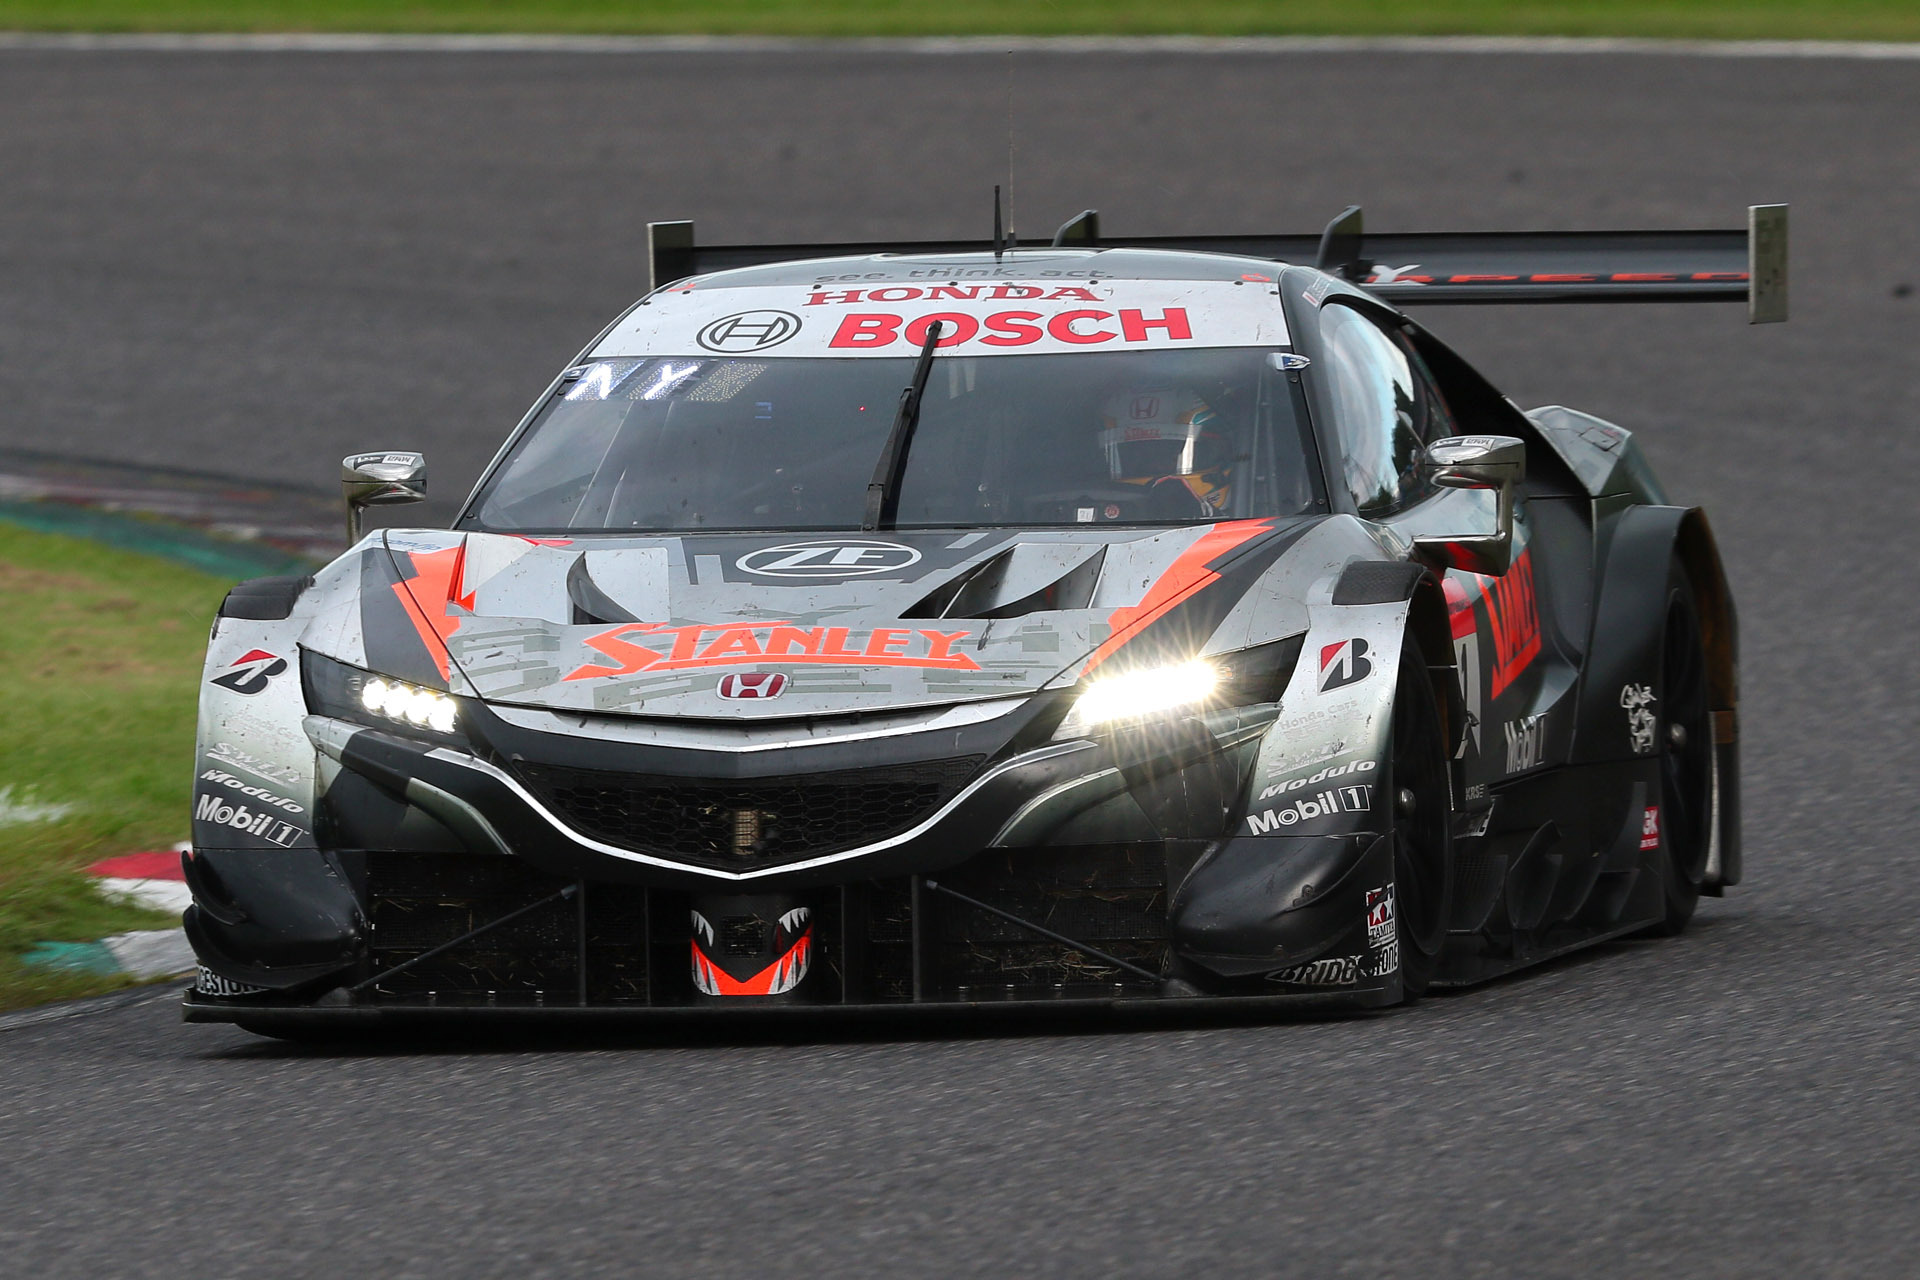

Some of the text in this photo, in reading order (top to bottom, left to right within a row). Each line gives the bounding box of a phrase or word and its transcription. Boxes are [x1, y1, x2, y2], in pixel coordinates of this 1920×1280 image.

[909, 267, 1026, 278] think.
[1039, 268, 1115, 279] act.
[802, 285, 1105, 306] HONDA
[829, 307, 1193, 350] BOSCH
[766, 548, 886, 571] ZF
[561, 620, 984, 682] STANLEY
[200, 769, 304, 815] Modulo
[1259, 760, 1376, 800] Modulo
[195, 793, 273, 837] Mobil
[1246, 789, 1339, 836] Mobil
